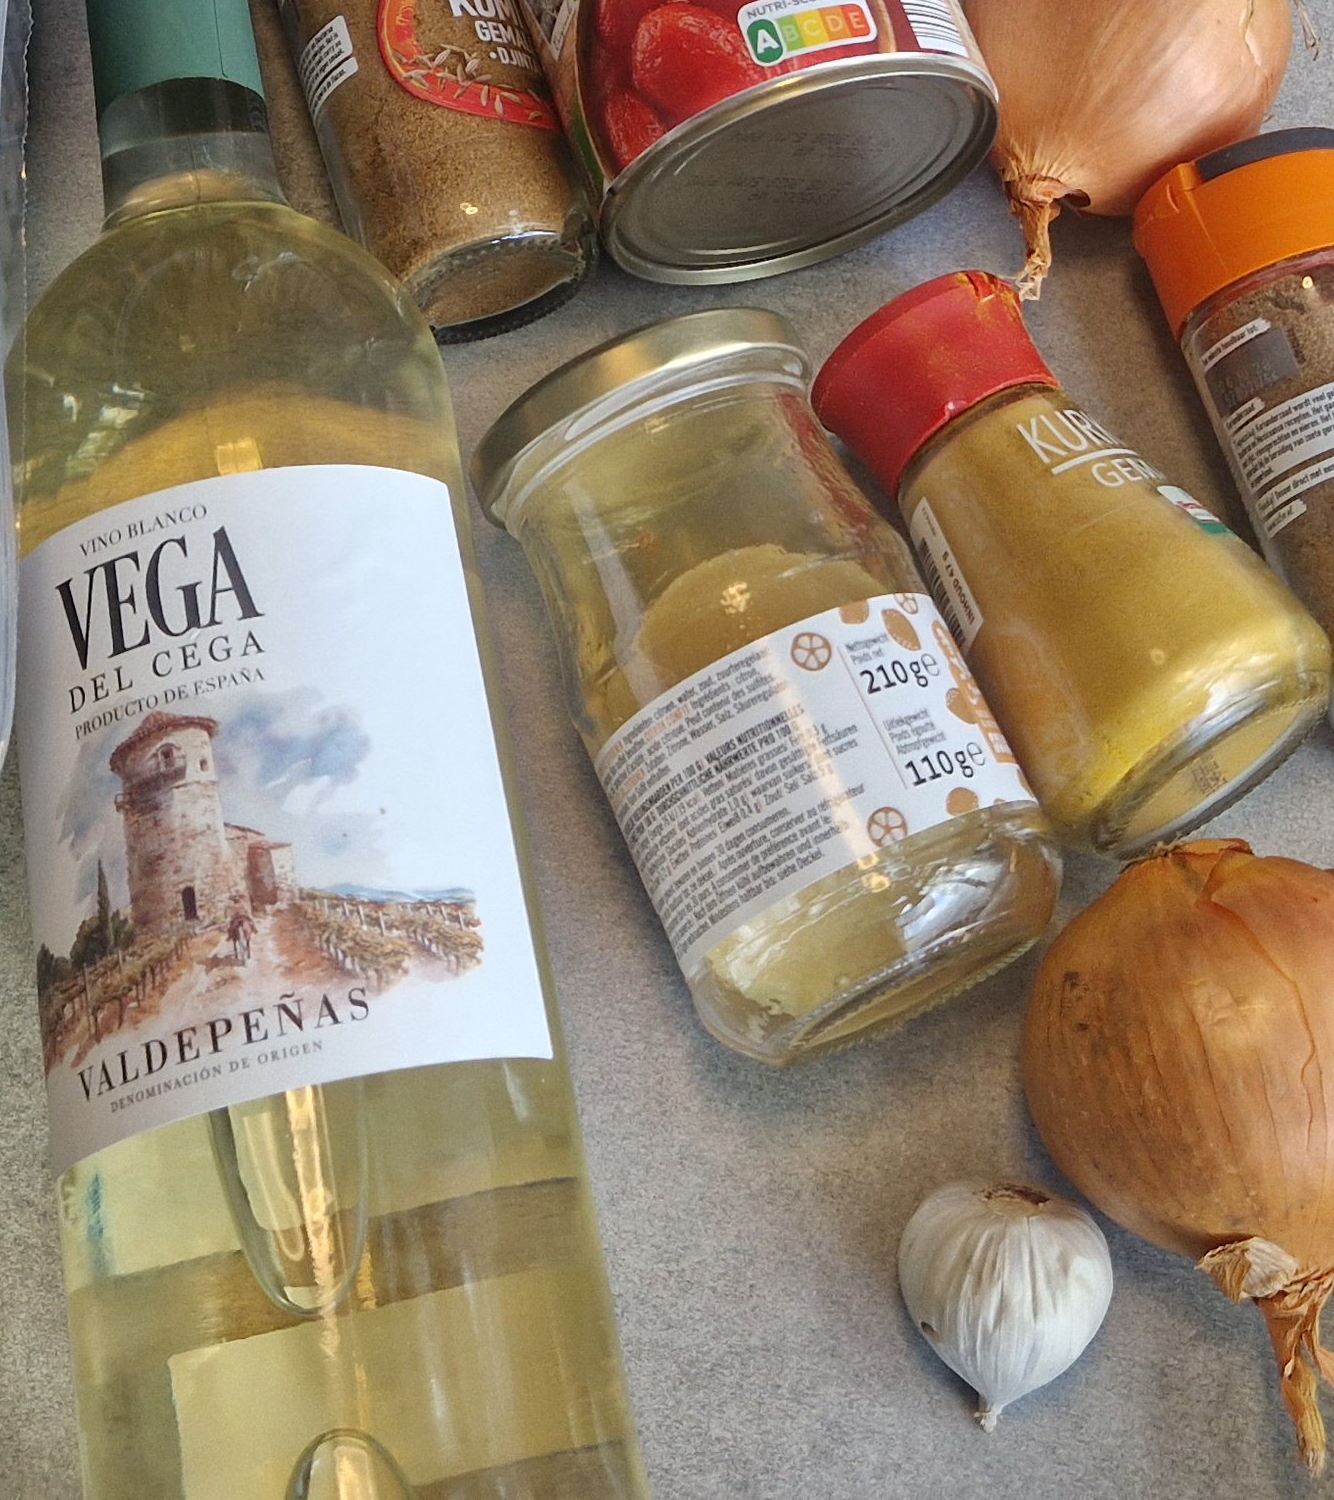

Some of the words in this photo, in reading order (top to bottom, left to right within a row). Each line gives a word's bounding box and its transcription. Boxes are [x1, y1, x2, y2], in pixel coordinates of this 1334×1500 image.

[757, 30, 780, 53] A
[78, 530, 123, 558] VINO
[127, 504, 208, 541] BLANCO
[54, 525, 264, 671] VEGA
[68, 668, 134, 714] DEL
[151, 631, 266, 680] CEGA
[74, 694, 158, 740] PRODUCTO
[163, 684, 188, 705] DE
[193, 667, 265, 698] ESPAÑA
[77, 986, 372, 1103] VALDEPEÑAS
[110, 1063, 222, 1114] DENOMINACIÓN
[229, 1056, 251, 1073] DE
[256, 1038, 323, 1065] ORIGEN
